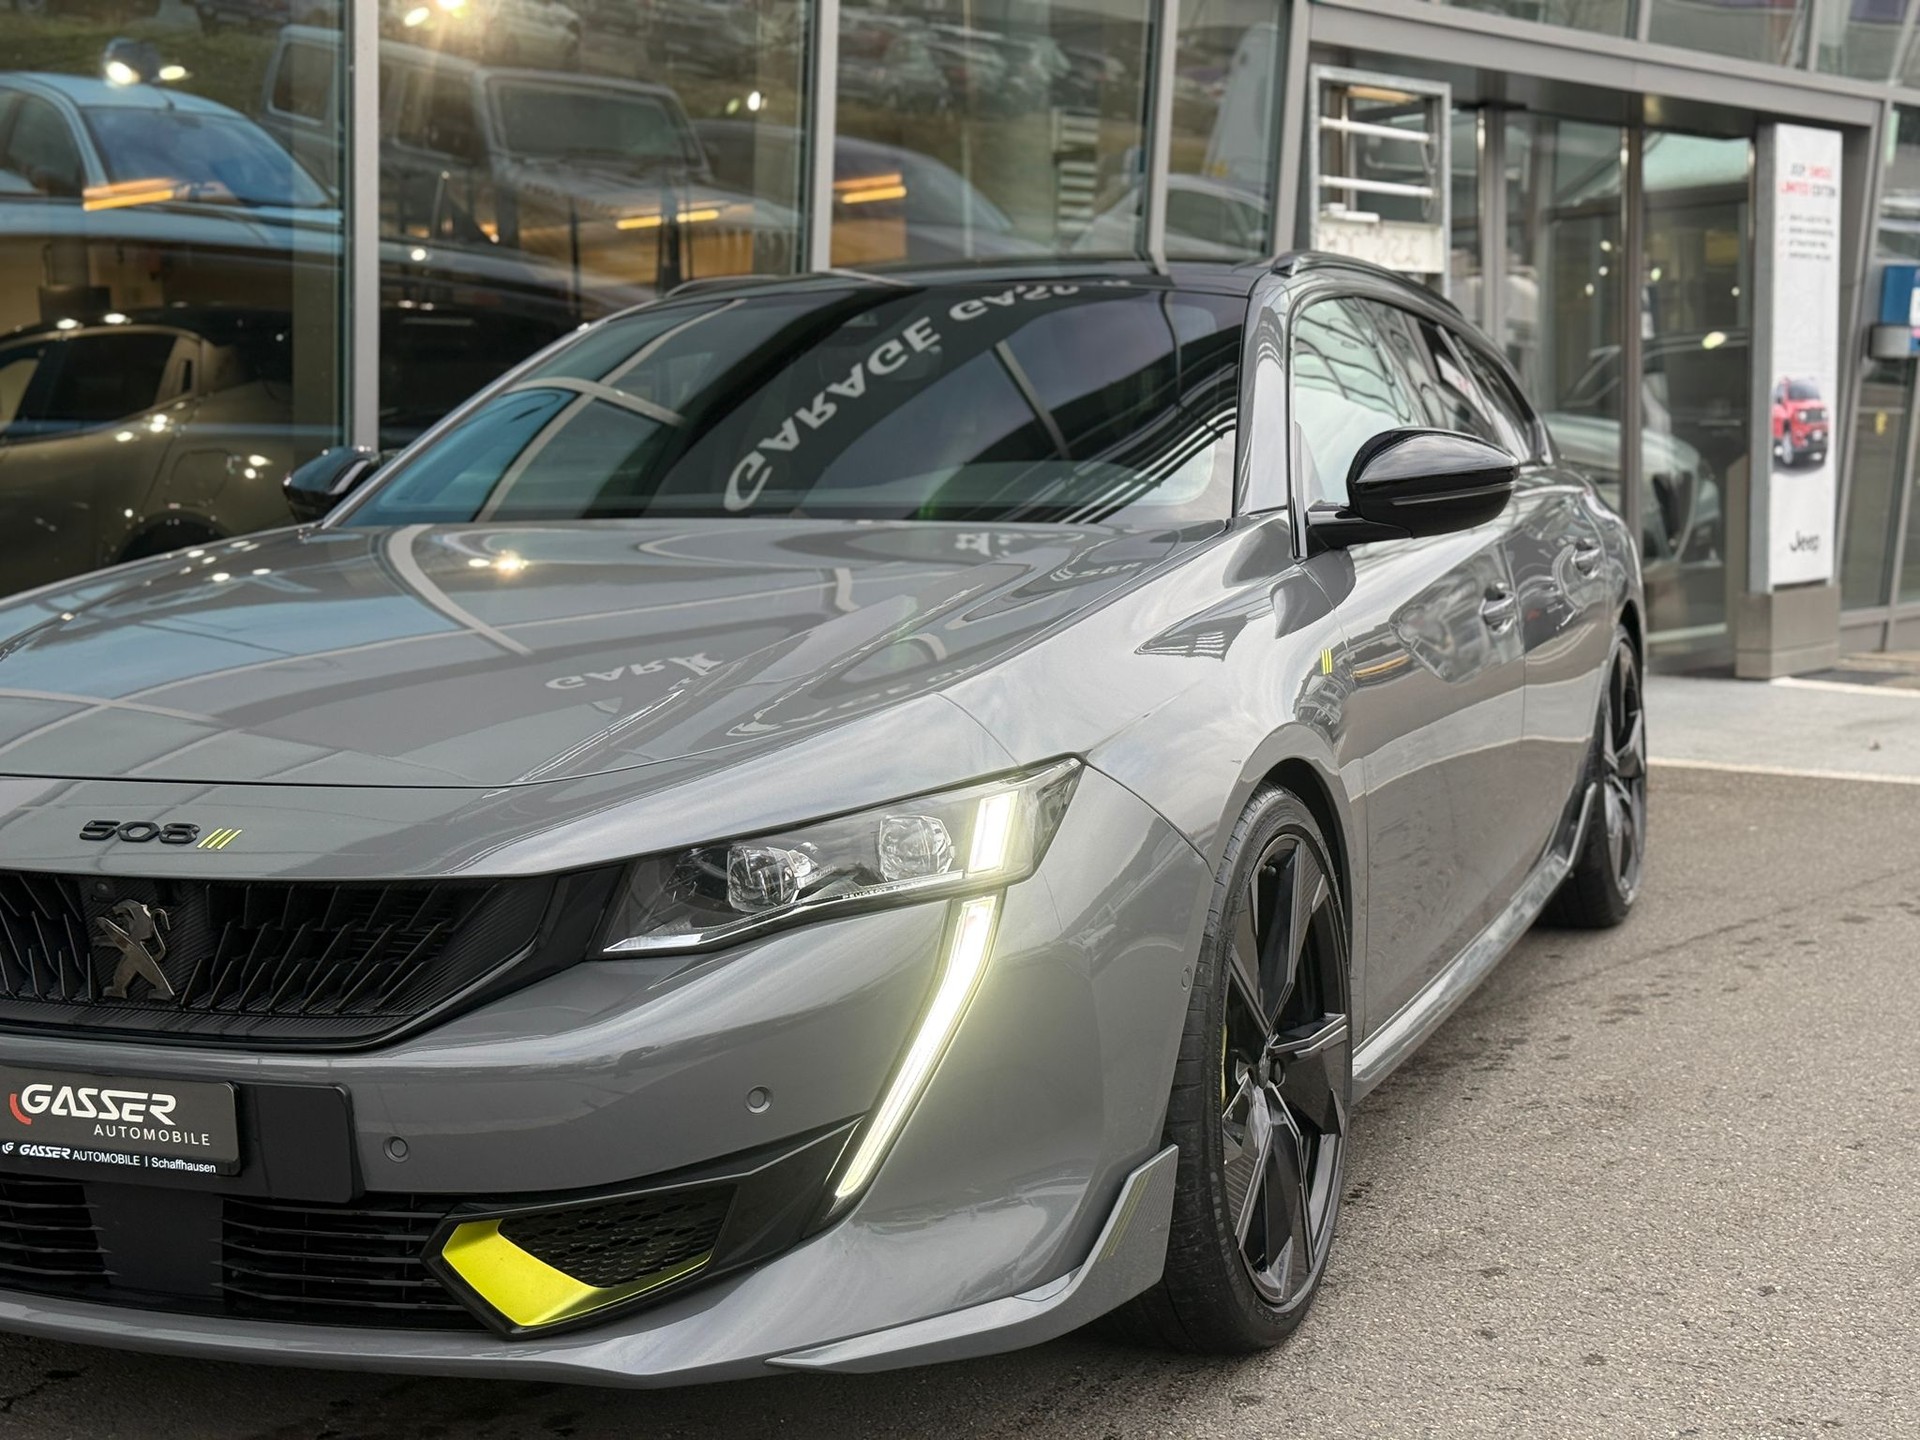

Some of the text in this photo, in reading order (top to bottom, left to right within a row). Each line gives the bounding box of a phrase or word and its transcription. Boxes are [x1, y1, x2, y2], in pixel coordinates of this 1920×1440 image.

[79, 820, 201, 844] 508
[21, 1083, 177, 1125] GASSER
[94, 1124, 211, 1146] AUTOMOBILE
[19, 1144, 71, 1159] GASSER
[73, 1150, 141, 1166] AUTOMOBILE
[151, 1157, 217, 1173] Schaffhausen
